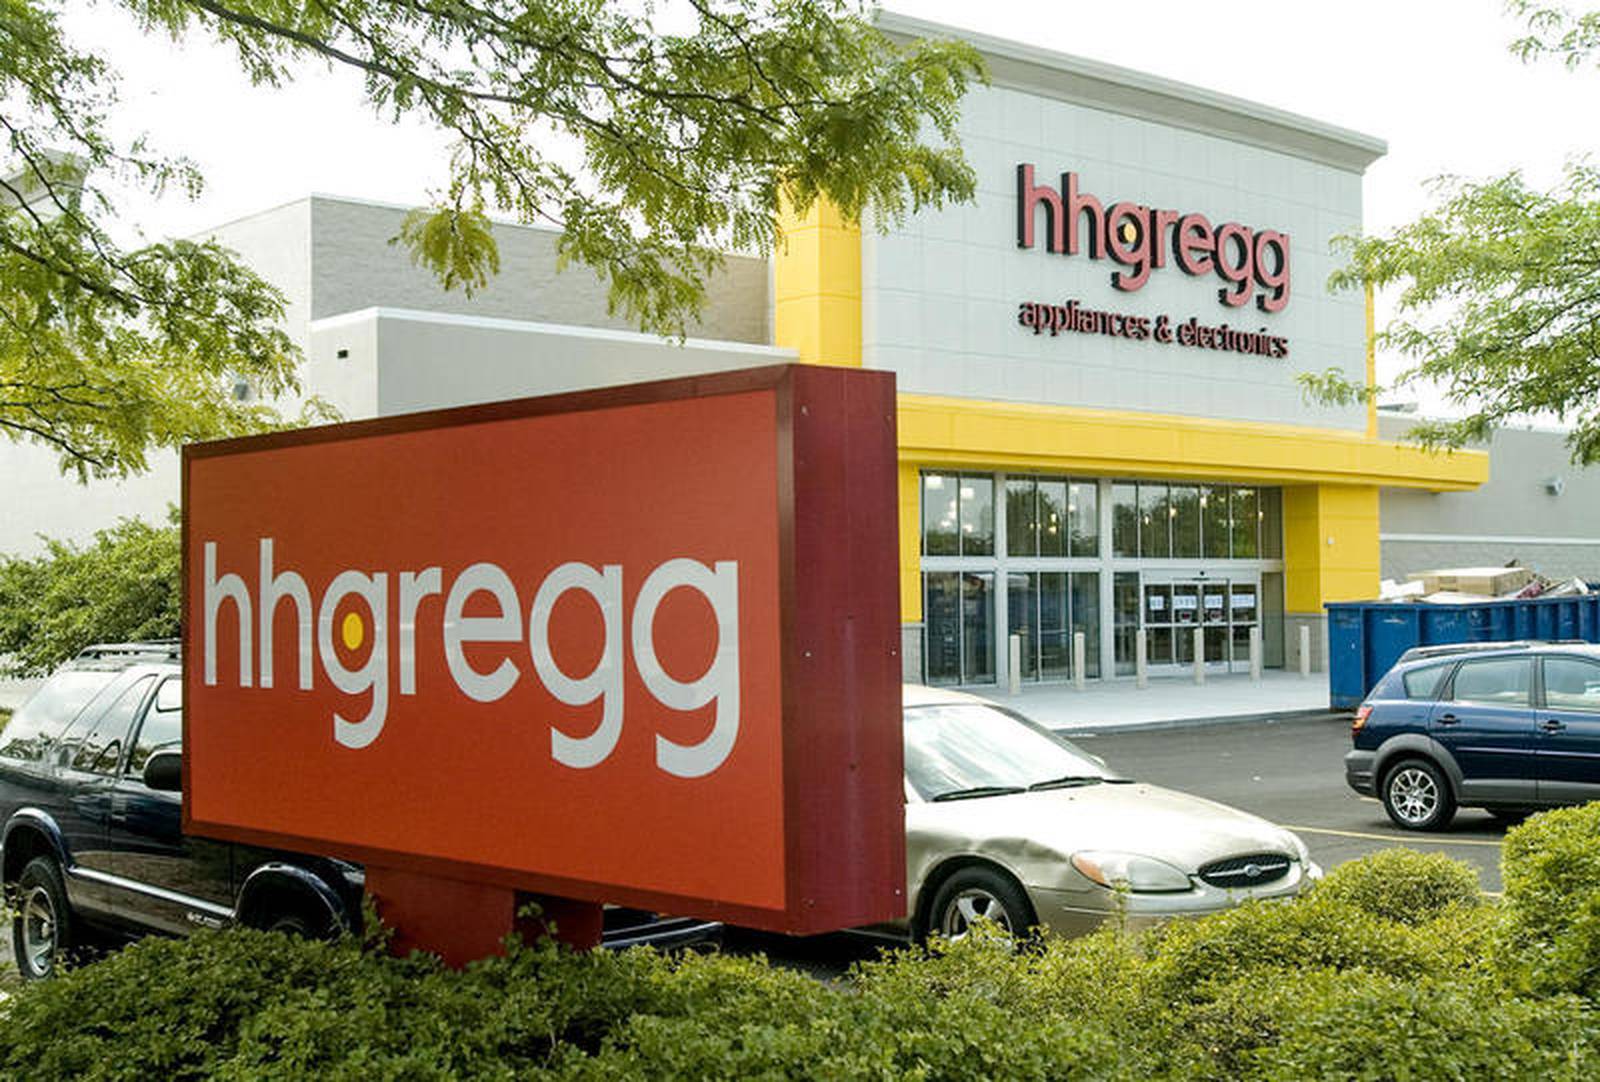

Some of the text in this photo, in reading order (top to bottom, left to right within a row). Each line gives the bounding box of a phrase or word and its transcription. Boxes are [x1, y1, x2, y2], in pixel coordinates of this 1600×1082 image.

[1017, 163, 1291, 313] hhgregg
[1019, 300, 1289, 358] appliances & electronics
[204, 537, 740, 778] hhgregg
